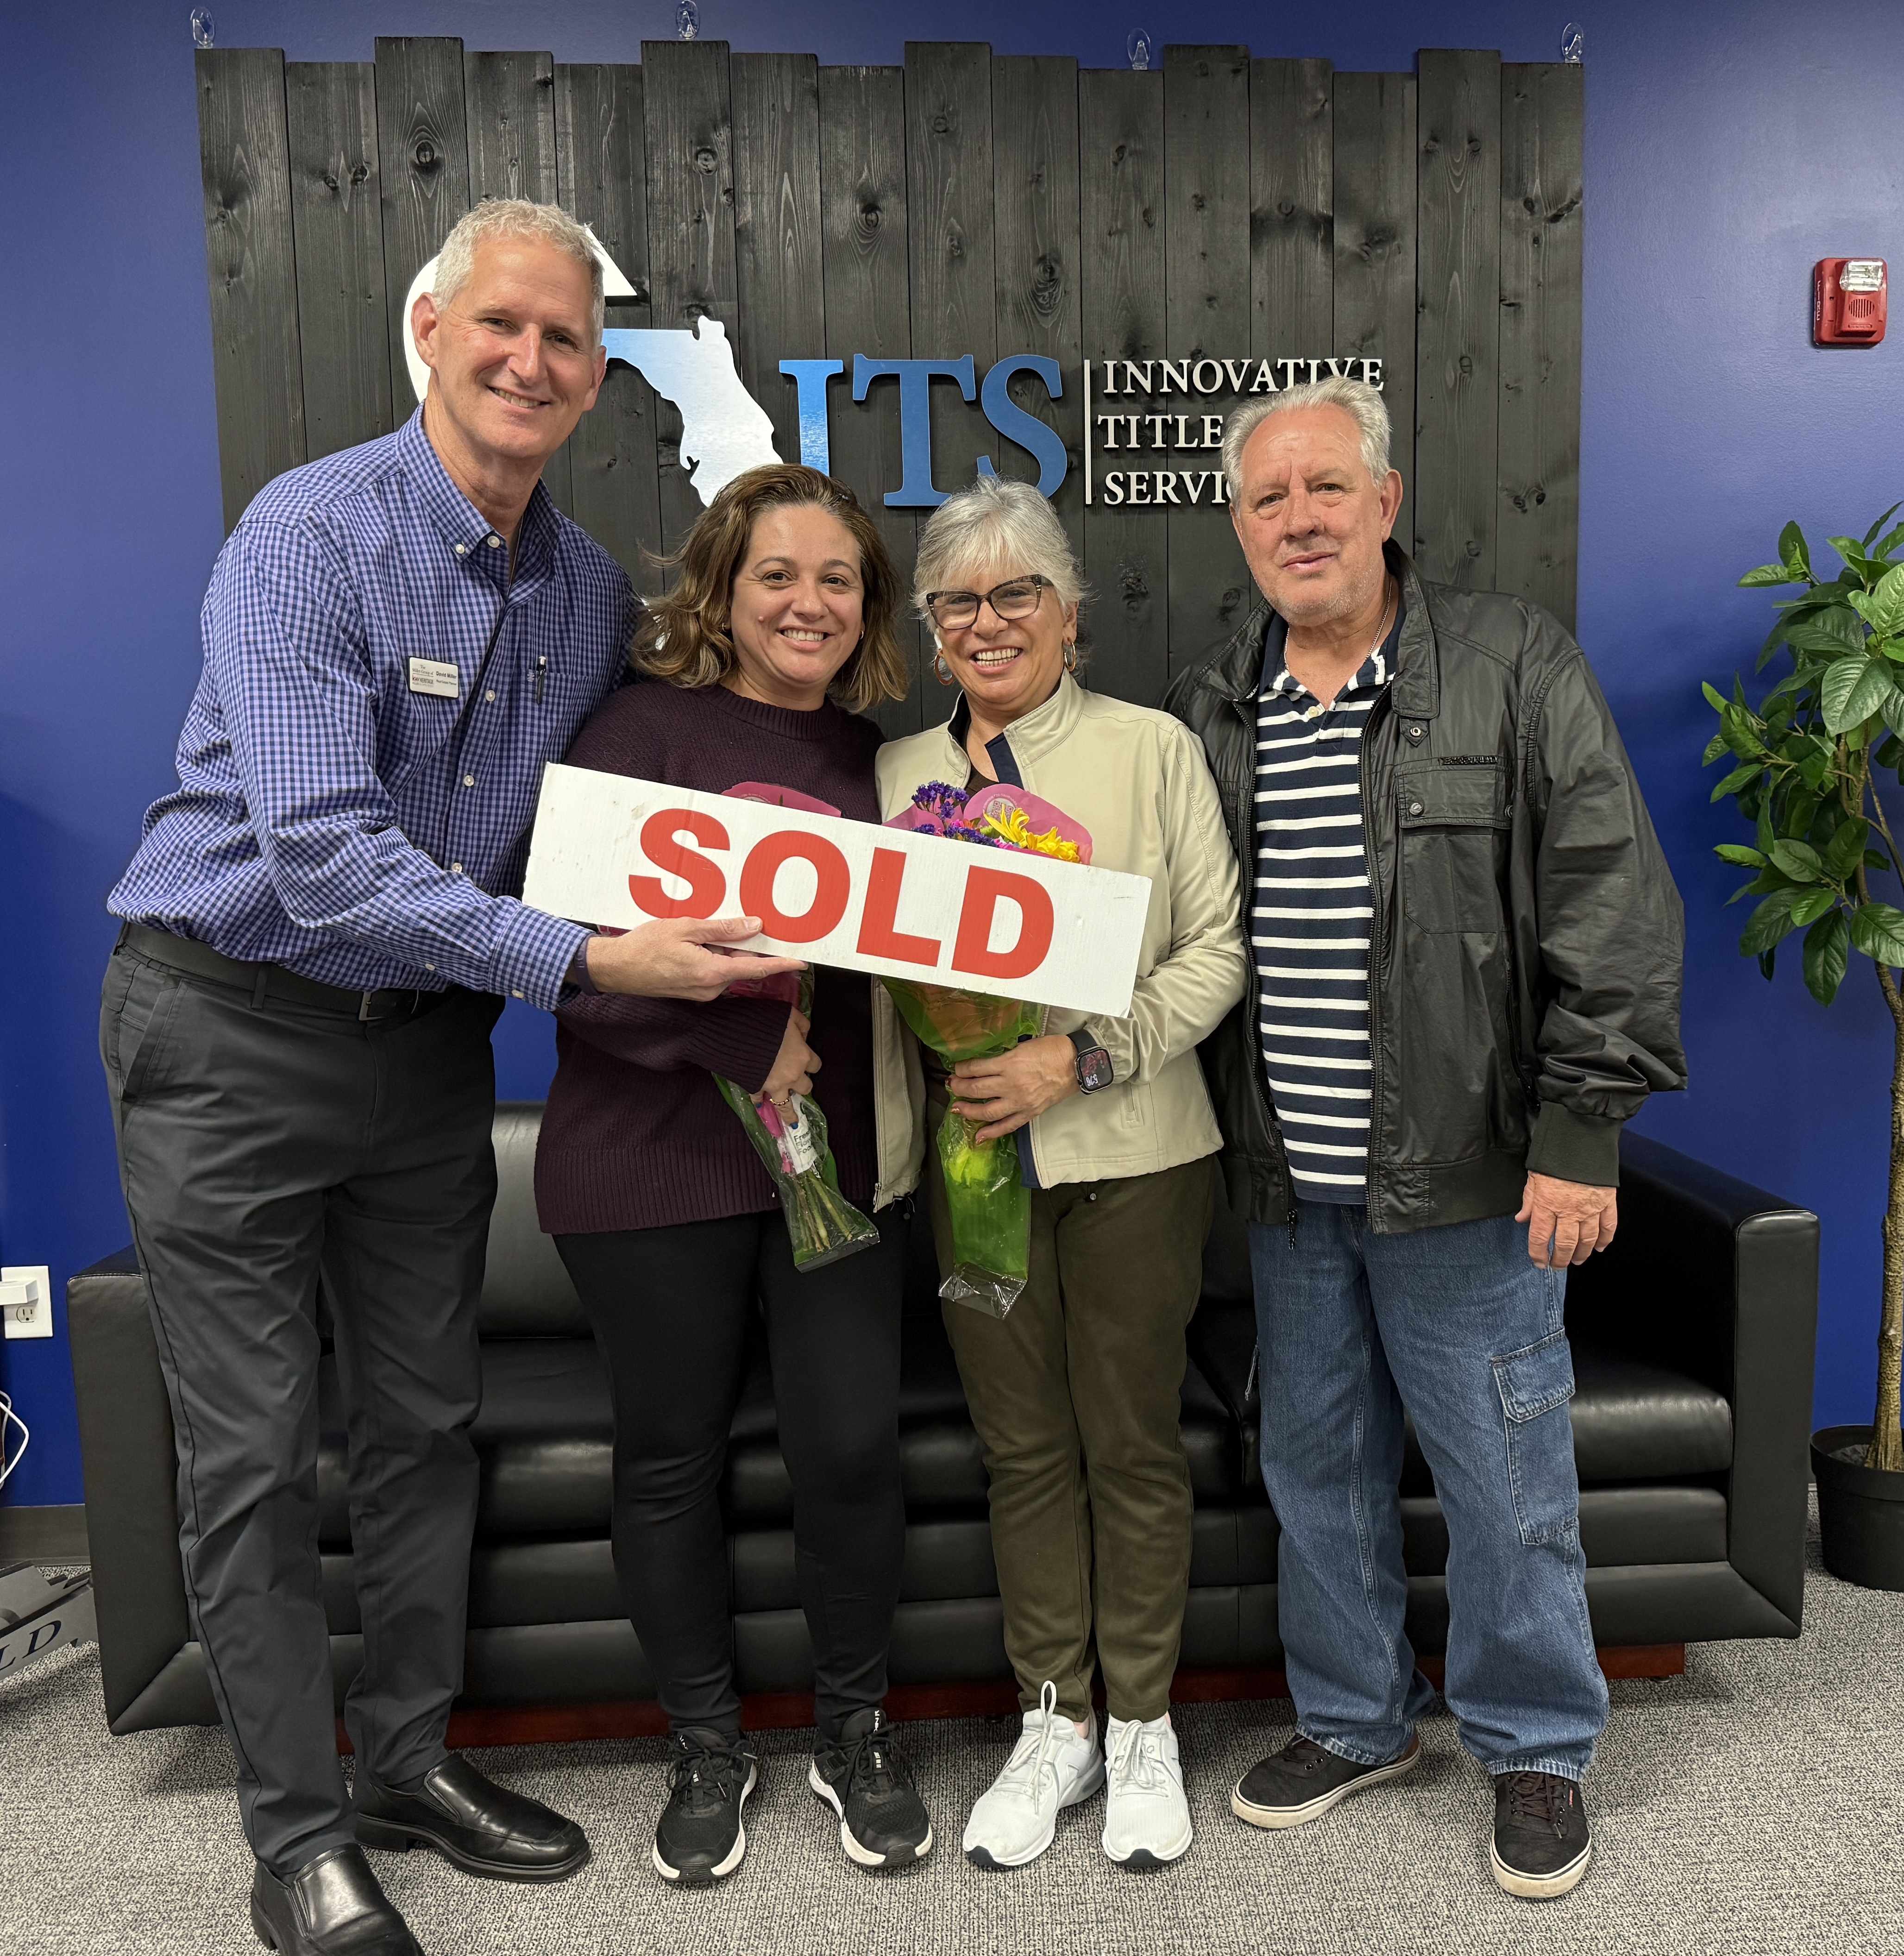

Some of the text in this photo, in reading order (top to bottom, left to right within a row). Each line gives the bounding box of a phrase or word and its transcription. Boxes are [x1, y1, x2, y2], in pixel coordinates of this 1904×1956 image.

[1103, 357, 1384, 393] INNOVATIVE
[779, 353, 1068, 506] ITS
[1097, 414, 1225, 448] TITLE
[1104, 471, 1232, 505] SERVI
[629, 809, 1054, 979] SOLD
